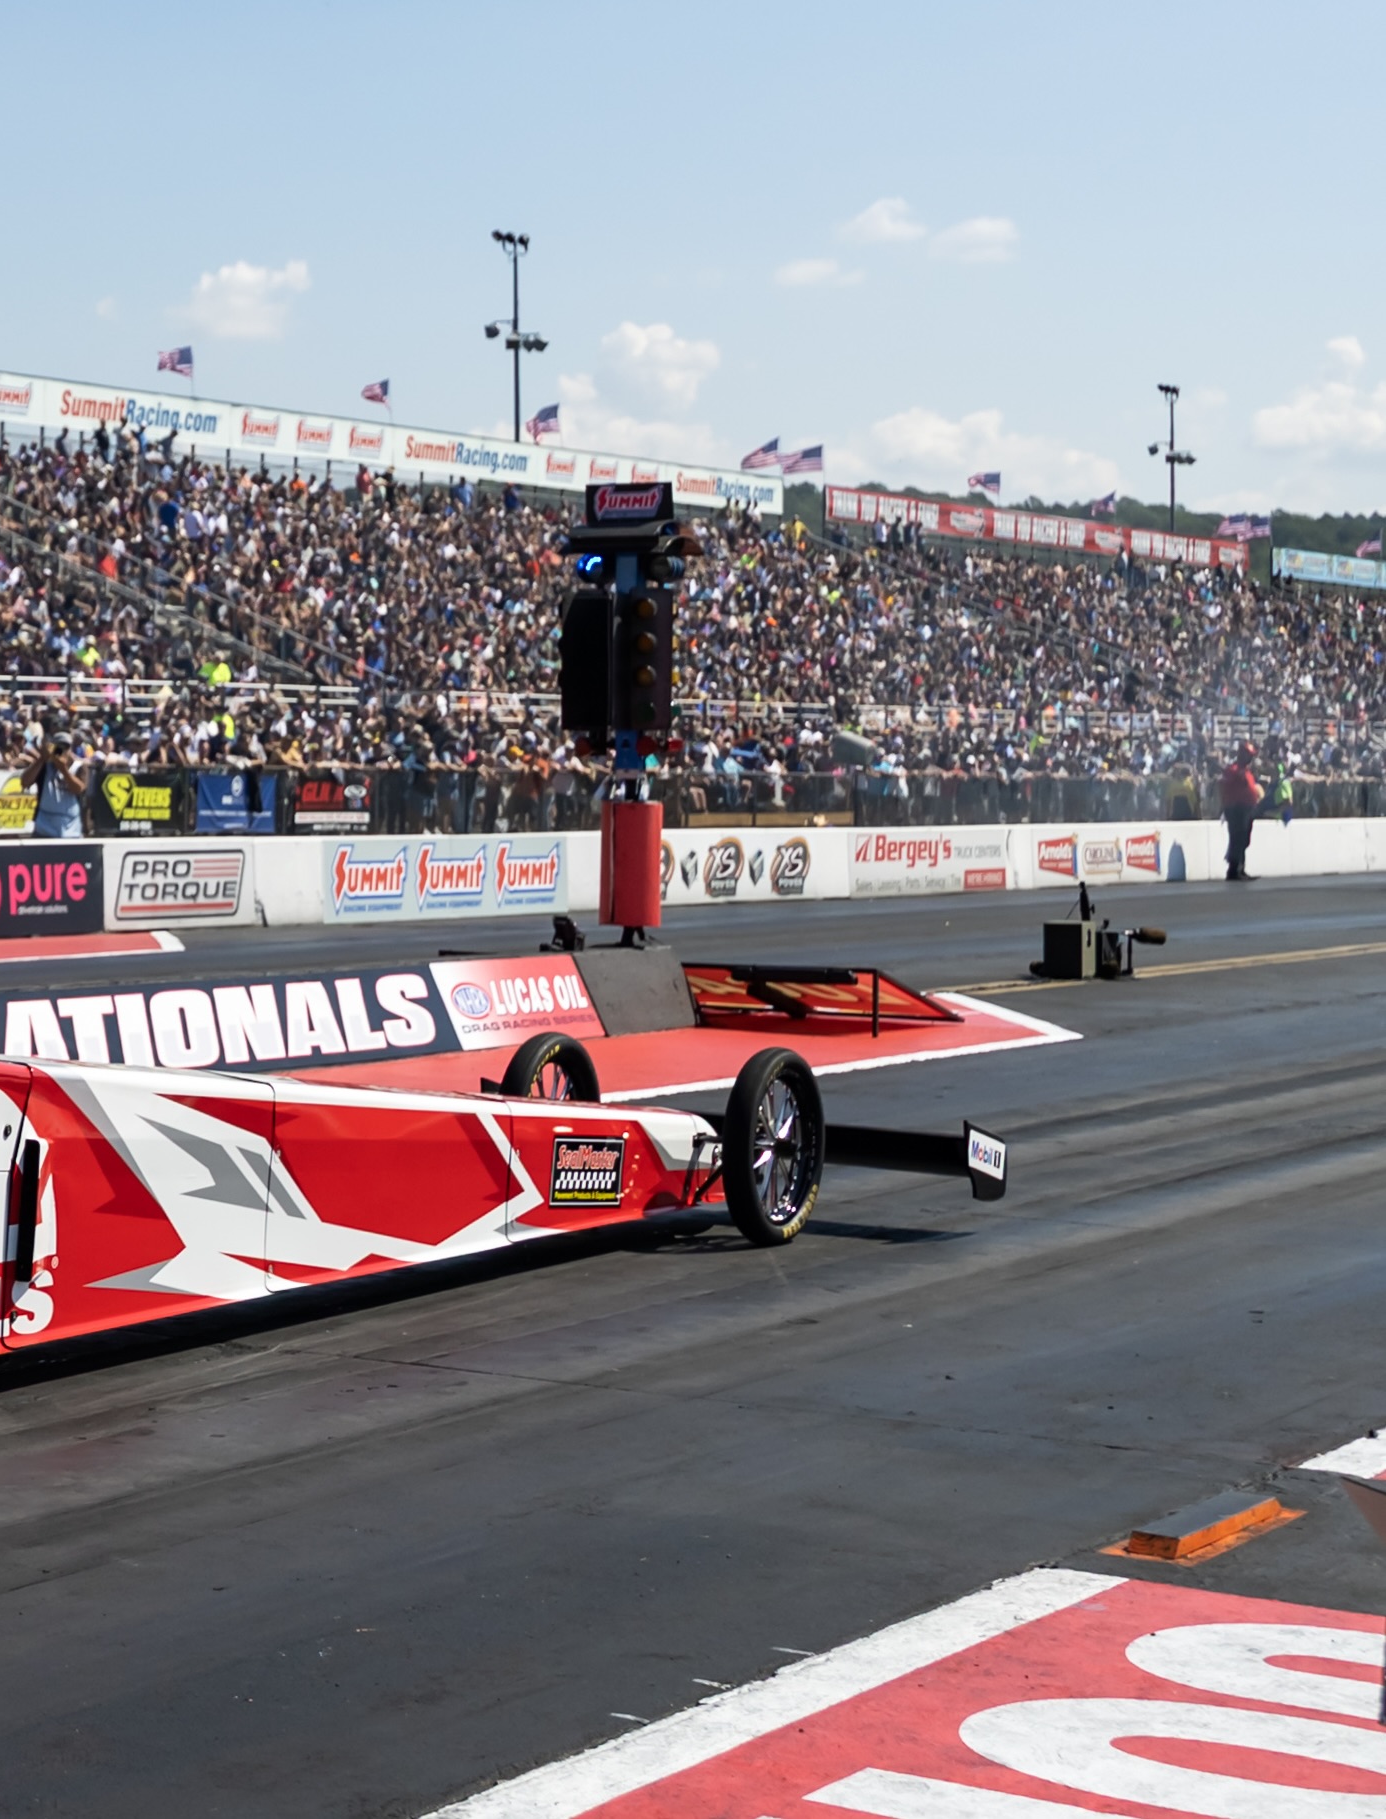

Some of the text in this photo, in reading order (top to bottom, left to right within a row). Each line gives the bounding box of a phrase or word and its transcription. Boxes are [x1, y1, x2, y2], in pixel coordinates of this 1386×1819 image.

[61, 389, 218, 434] SummitRacing.com
[405, 433, 528, 473] SummitRacing.com
[676, 471, 775, 504] SummitRacing.com
[874, 832, 951, 868] Bergey's
[132, 859, 191, 878] PRO
[8, 862, 88, 916] pure
[124, 879, 237, 903] TORQUE
[489, 975, 554, 1016] LUCAS
[553, 975, 589, 1010] OIL
[462, 1013, 596, 1034] DRAG RACING SERIES
[556, 1144, 620, 1170] SealMaster
[971, 1140, 993, 1165] Mobil
